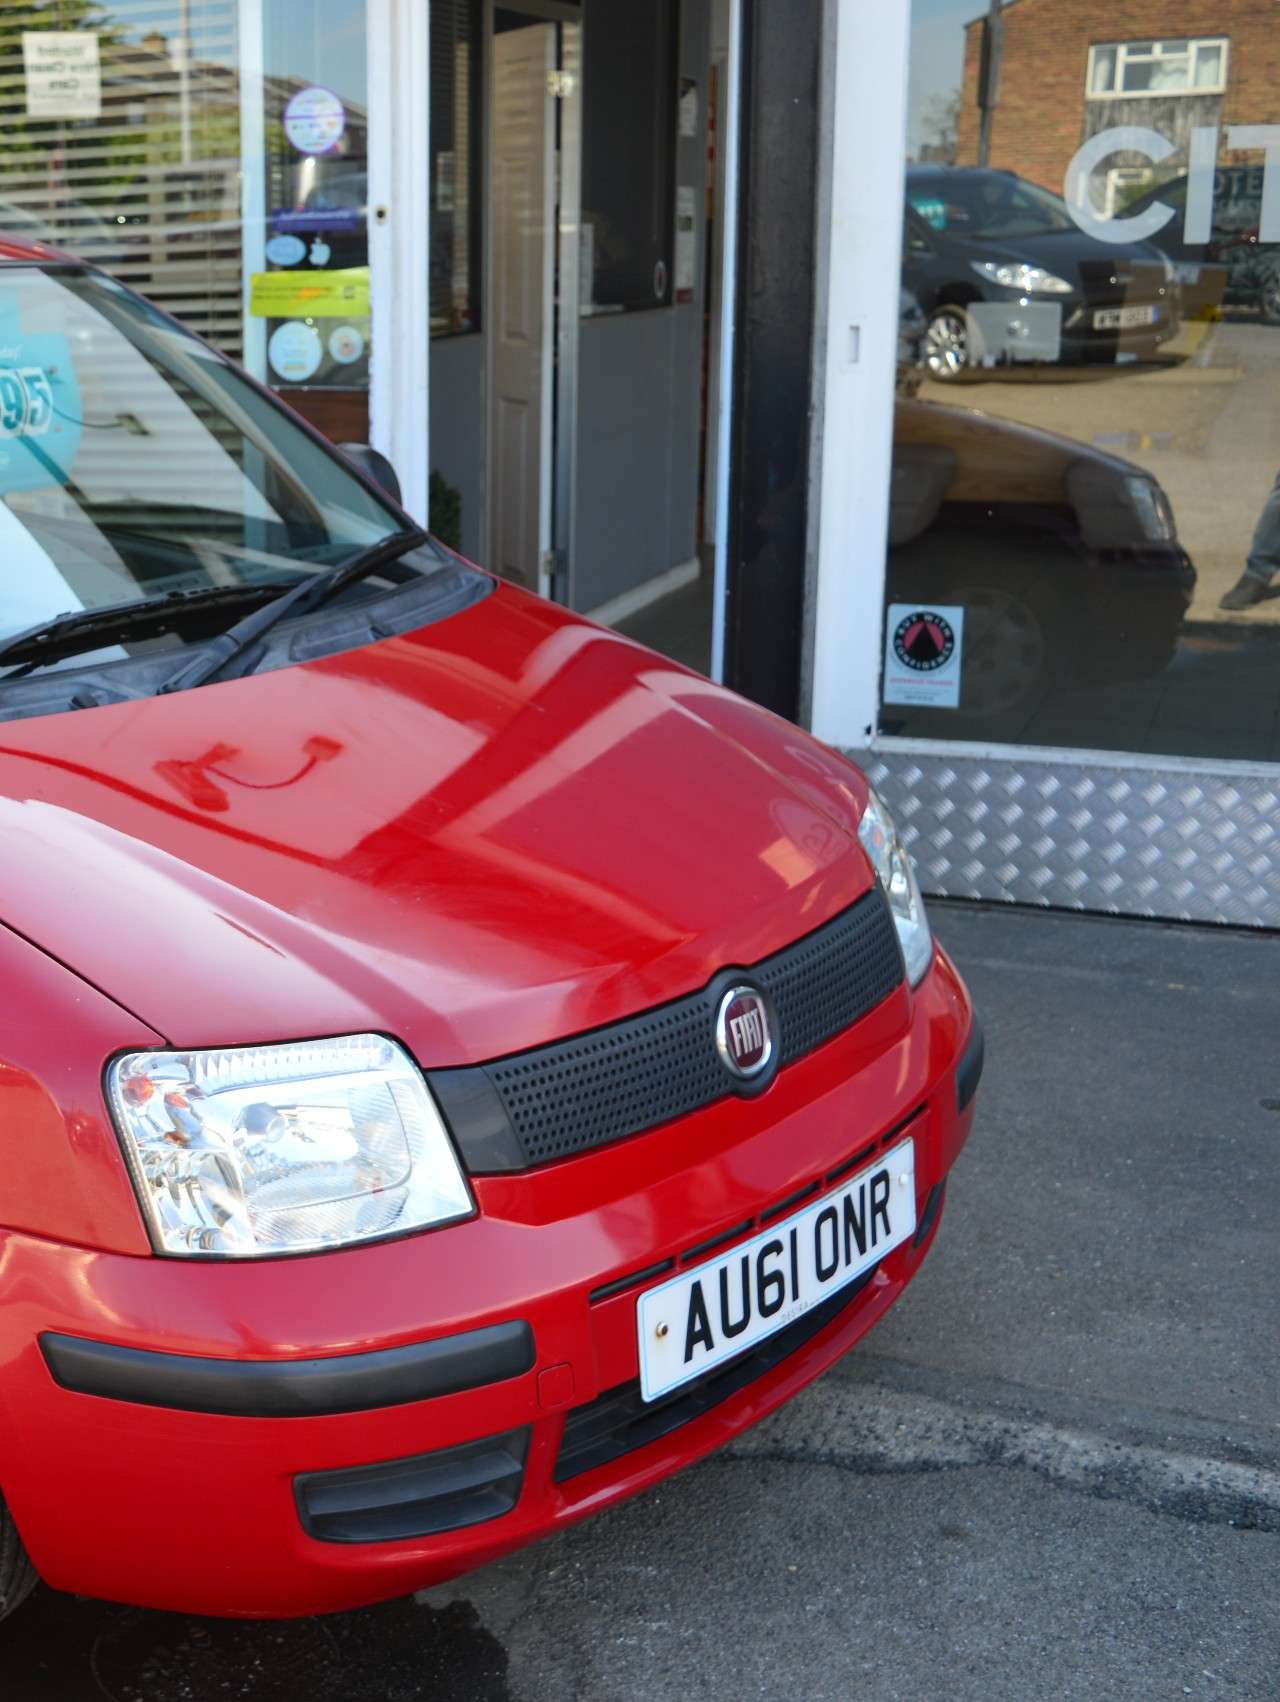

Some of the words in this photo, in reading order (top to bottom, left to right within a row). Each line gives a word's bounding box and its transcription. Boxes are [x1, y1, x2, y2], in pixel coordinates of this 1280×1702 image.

[730, 1007, 765, 1057] FIAT
[683, 1228, 799, 1364] AU61
[815, 1168, 892, 1283] ONR
